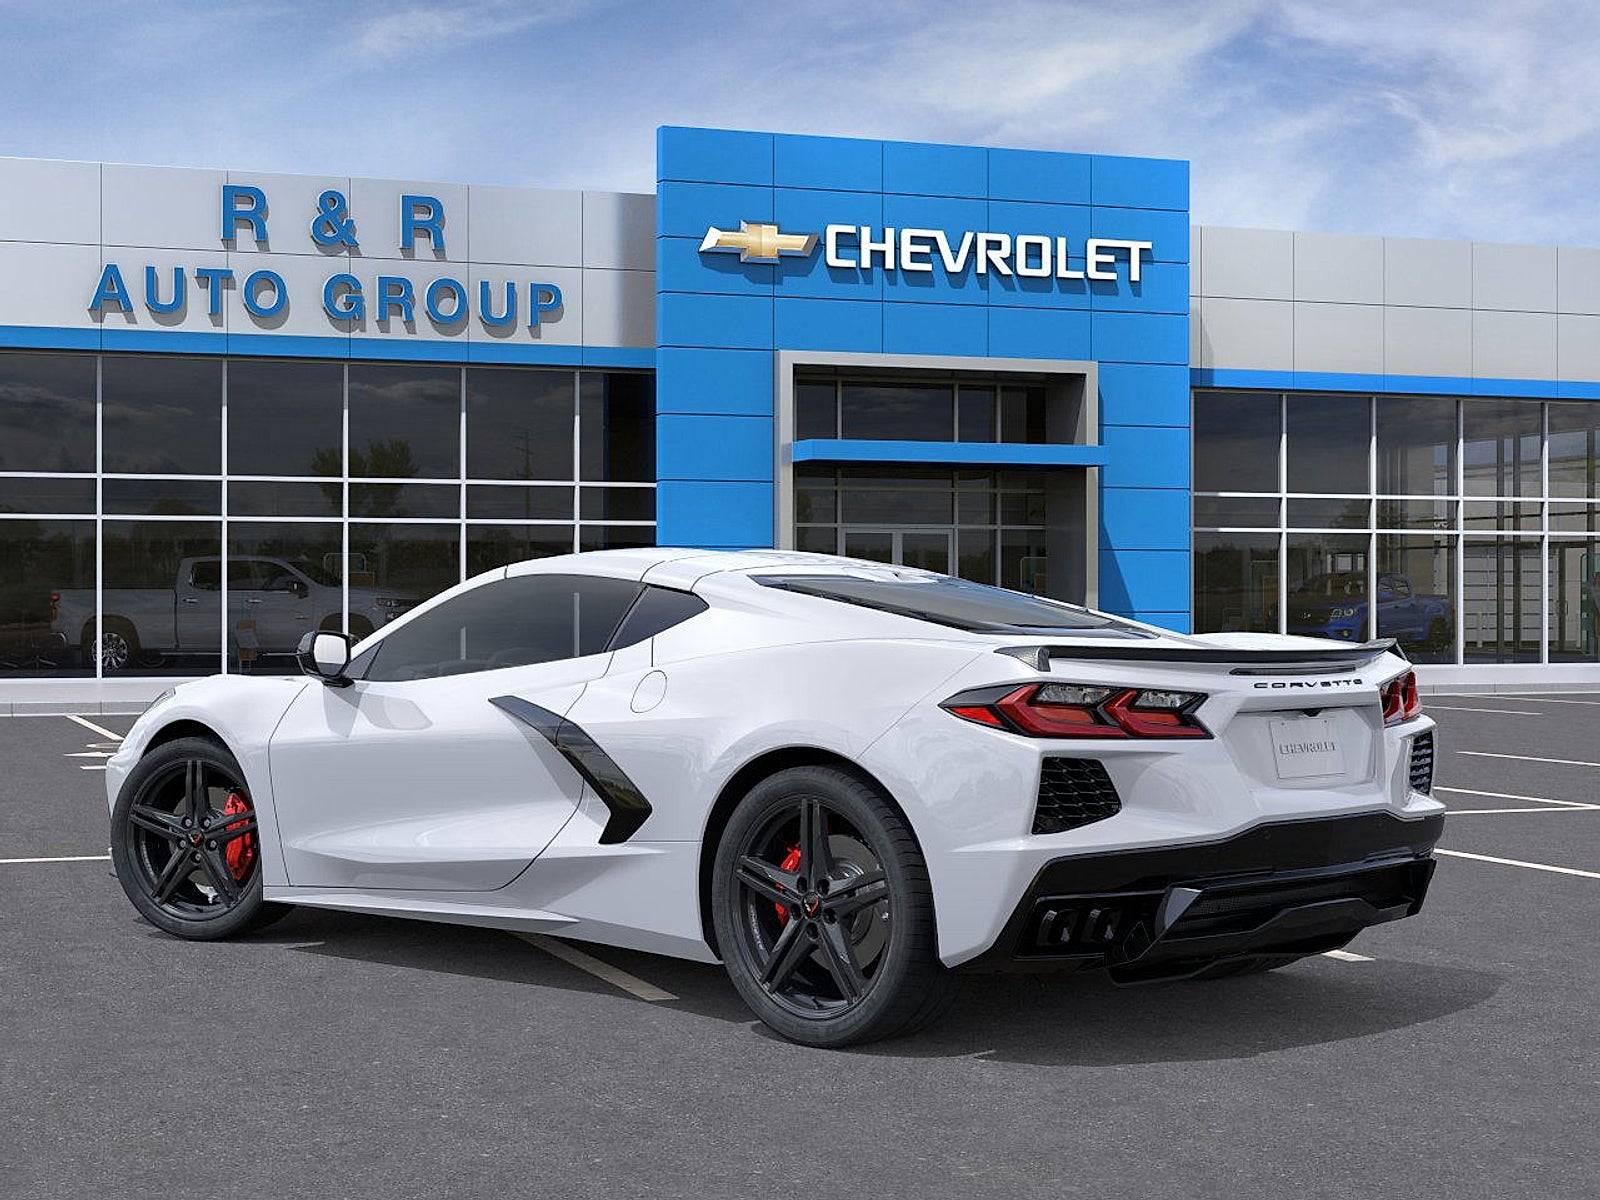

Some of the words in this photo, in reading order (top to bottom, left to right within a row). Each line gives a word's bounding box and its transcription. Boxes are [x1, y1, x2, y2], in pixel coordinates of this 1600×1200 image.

[221, 184, 268, 242] R
[310, 190, 358, 246] &
[400, 195, 445, 250] R
[826, 224, 1152, 281] CHEVROLET
[90, 264, 288, 317] AUTO
[322, 273, 563, 327] GROUP
[1254, 679, 1363, 689] CORVETTE
[1280, 742, 1336, 755] CHEVROLET
